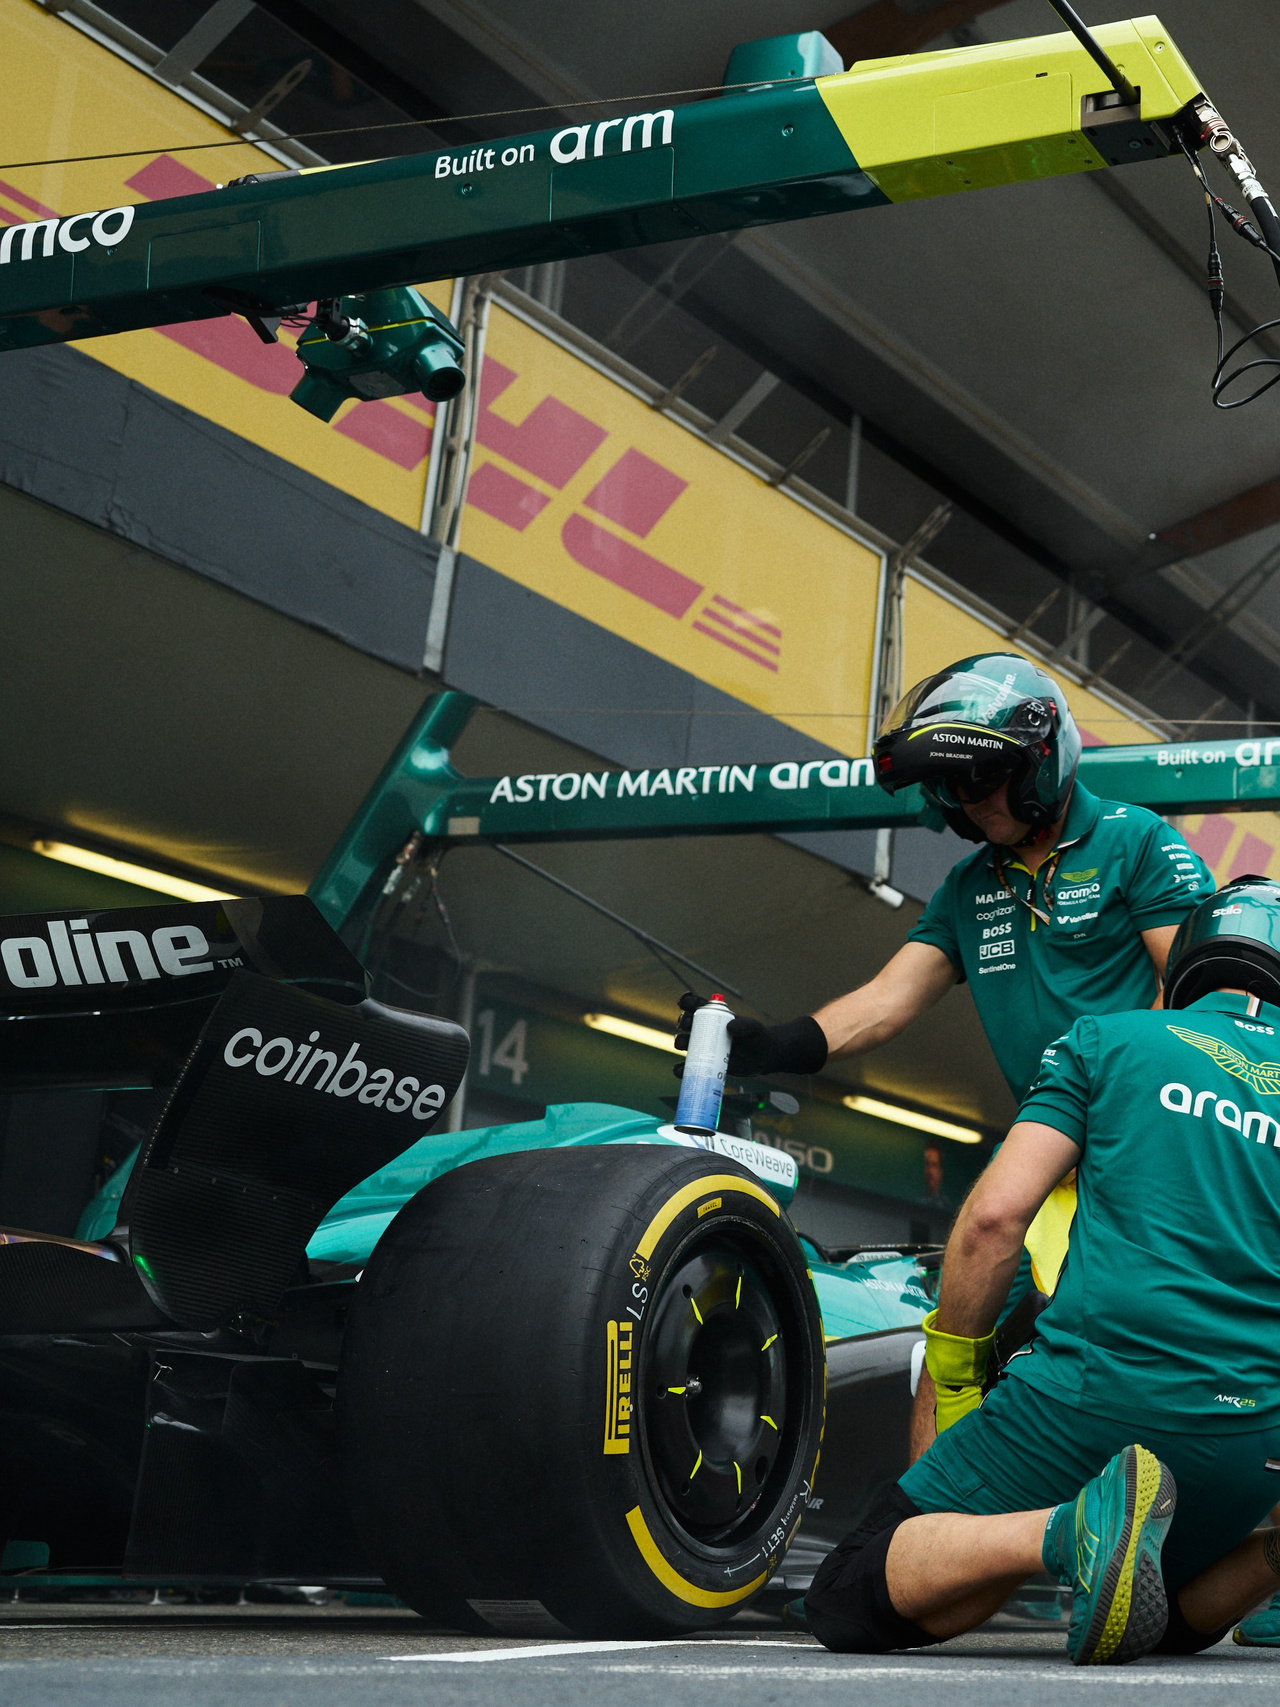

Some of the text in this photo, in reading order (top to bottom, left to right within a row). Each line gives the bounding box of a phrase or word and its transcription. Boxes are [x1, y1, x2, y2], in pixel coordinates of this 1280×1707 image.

[434, 109, 675, 179] Built on arm
[932, 733, 1003, 750] ASTON MARTIN
[945, 752, 973, 760] BRADBURY
[1157, 750, 1199, 766] Built
[1202, 752, 1226, 764] on
[489, 773, 608, 804] ASTON
[616, 764, 757, 798] MARTIN
[1069, 911, 1098, 923] Valvoline
[983, 922, 1012, 939] BOSS
[0, 918, 244, 988] oline TM
[981, 942, 1014, 958] JCB
[978, 962, 1016, 975] SentinelOne
[1234, 1020, 1275, 1035] BOSS
[478, 1009, 528, 1084] 14
[1218, 1046, 1249, 1071] ASTON
[223, 1030, 446, 1120] coinbase
[720, 1138, 793, 1178] CoreWeave
[861, 1278, 929, 1300] ASTON MARTIN
[604, 1320, 634, 1454] PIRELLI
[1214, 1394, 1256, 1408] AMR25
